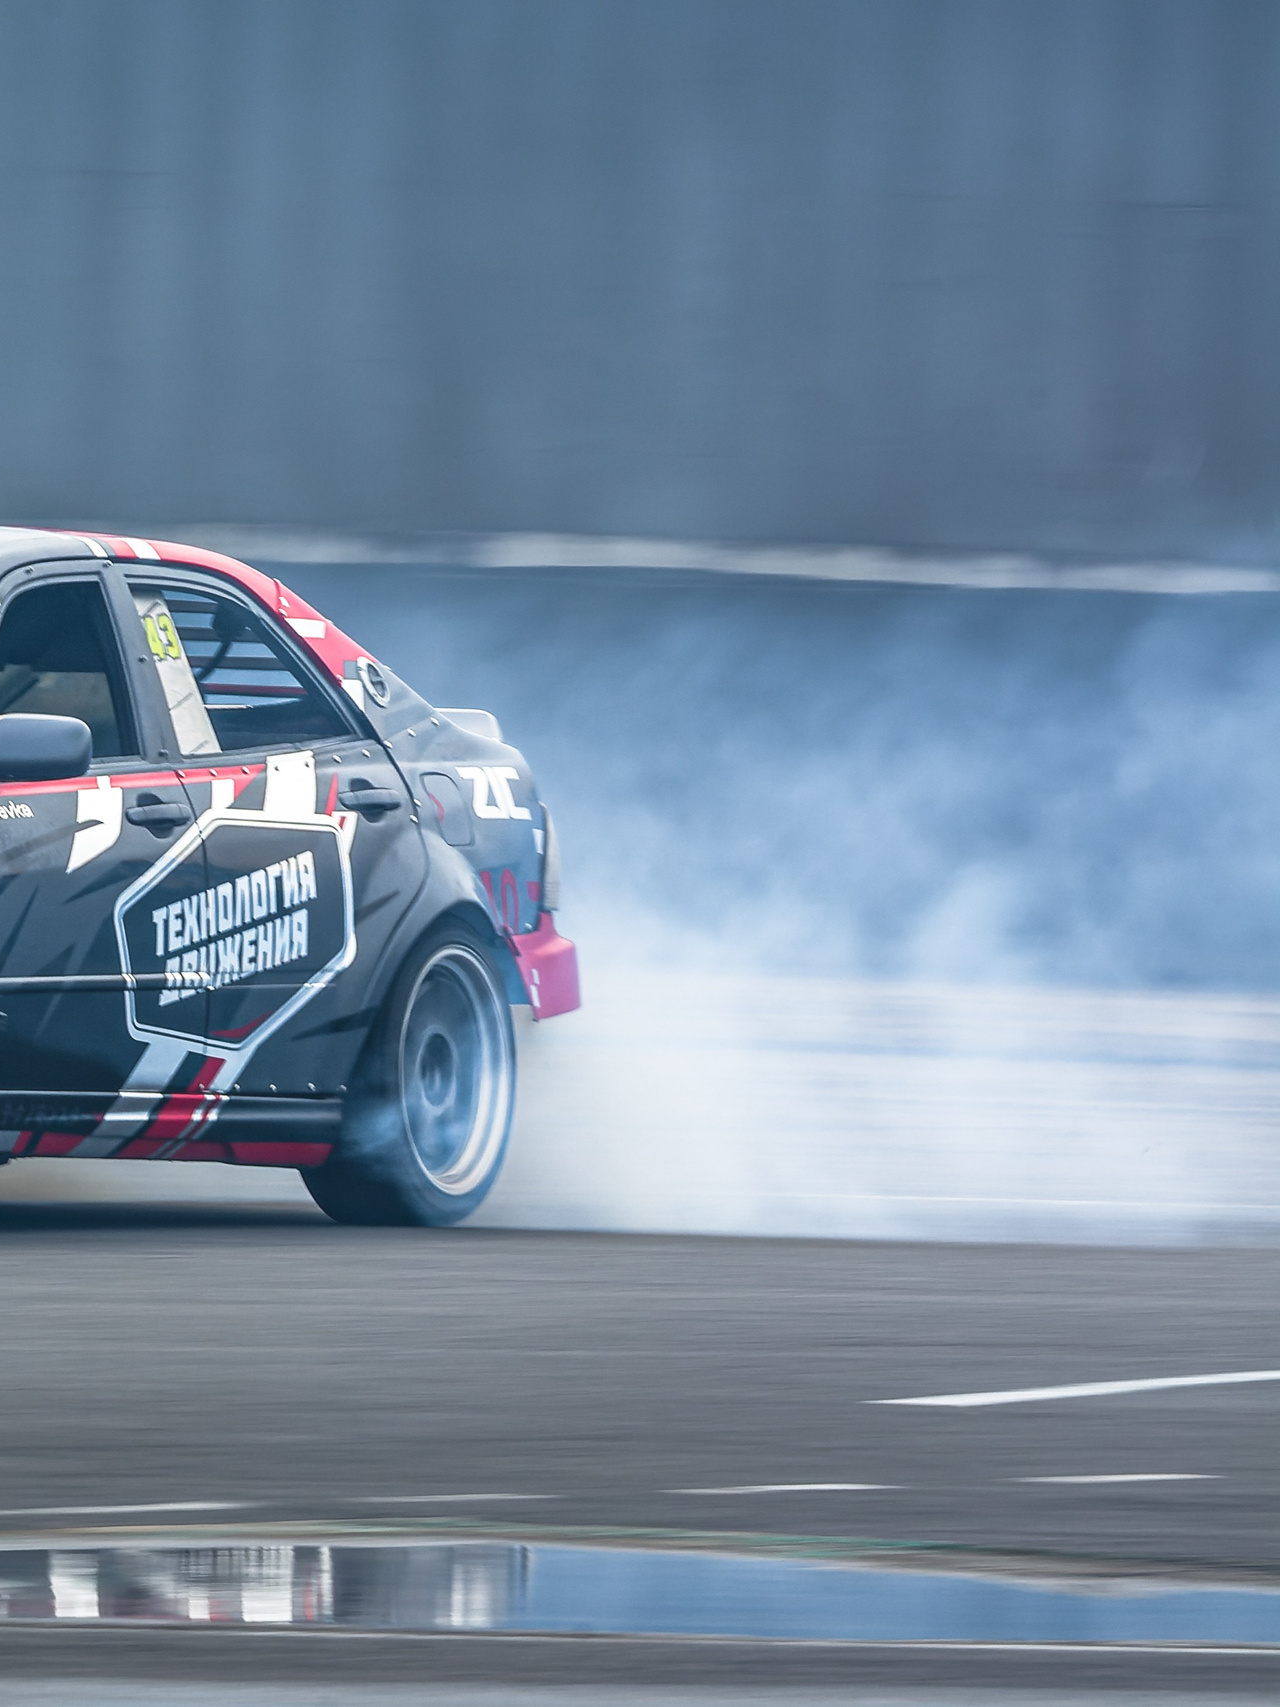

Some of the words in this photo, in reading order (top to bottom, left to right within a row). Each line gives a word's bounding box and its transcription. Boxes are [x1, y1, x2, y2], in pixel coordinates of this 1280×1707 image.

[143, 613, 181, 660] 43
[152, 850, 317, 957] ТЕХНОЛОГИЯ
[158, 907, 308, 1007] ДВИЖЕНИЯ
